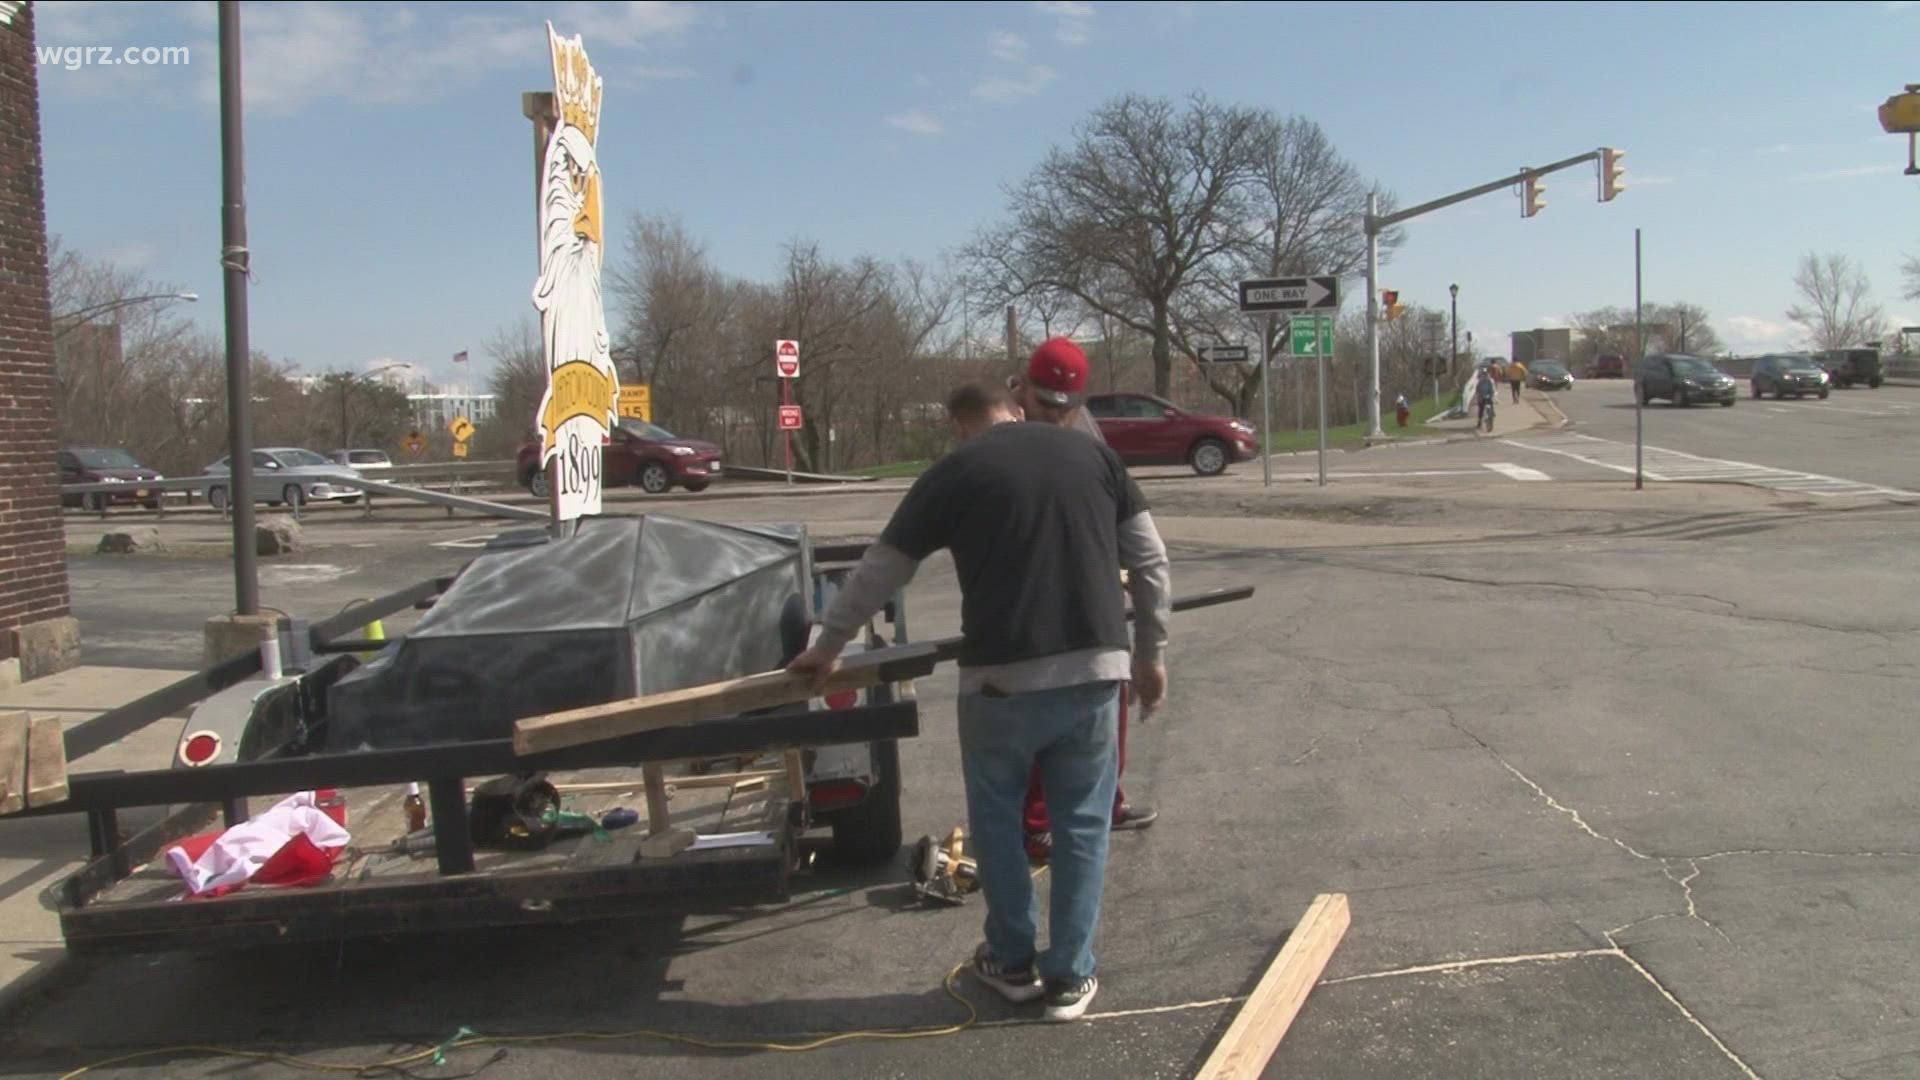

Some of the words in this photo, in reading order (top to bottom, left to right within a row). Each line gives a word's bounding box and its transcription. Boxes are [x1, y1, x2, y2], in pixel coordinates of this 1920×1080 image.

[1254, 289, 1278, 301] ONE
[1282, 288, 1306, 299] WAY
[625, 406, 643, 417] 15
